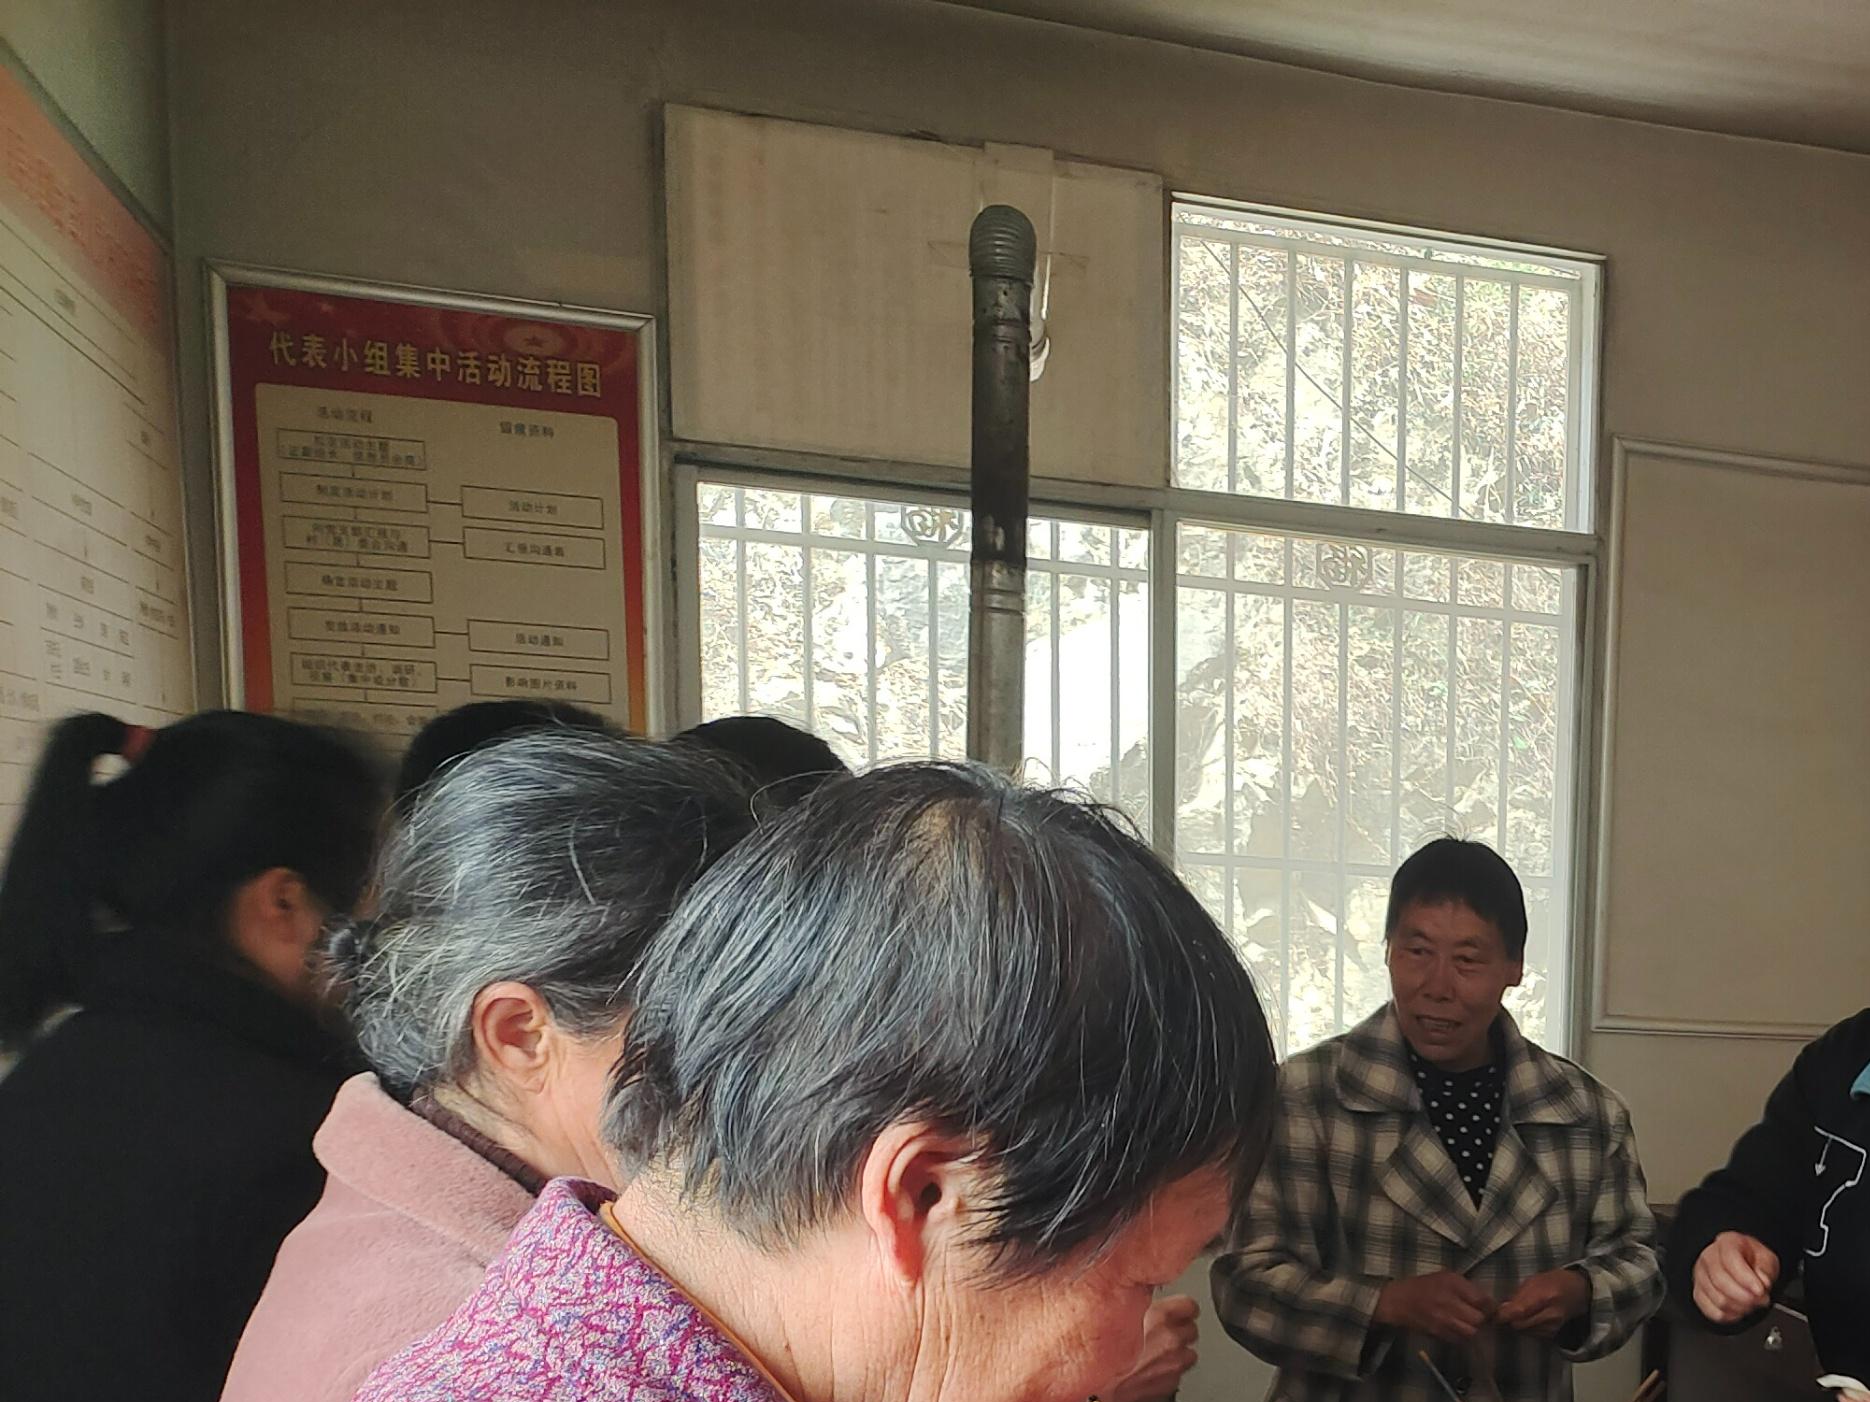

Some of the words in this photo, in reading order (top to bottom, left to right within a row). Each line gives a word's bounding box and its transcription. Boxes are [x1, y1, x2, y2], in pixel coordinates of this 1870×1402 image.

[269, 331, 603, 398] 代表小组集中活动流程图
